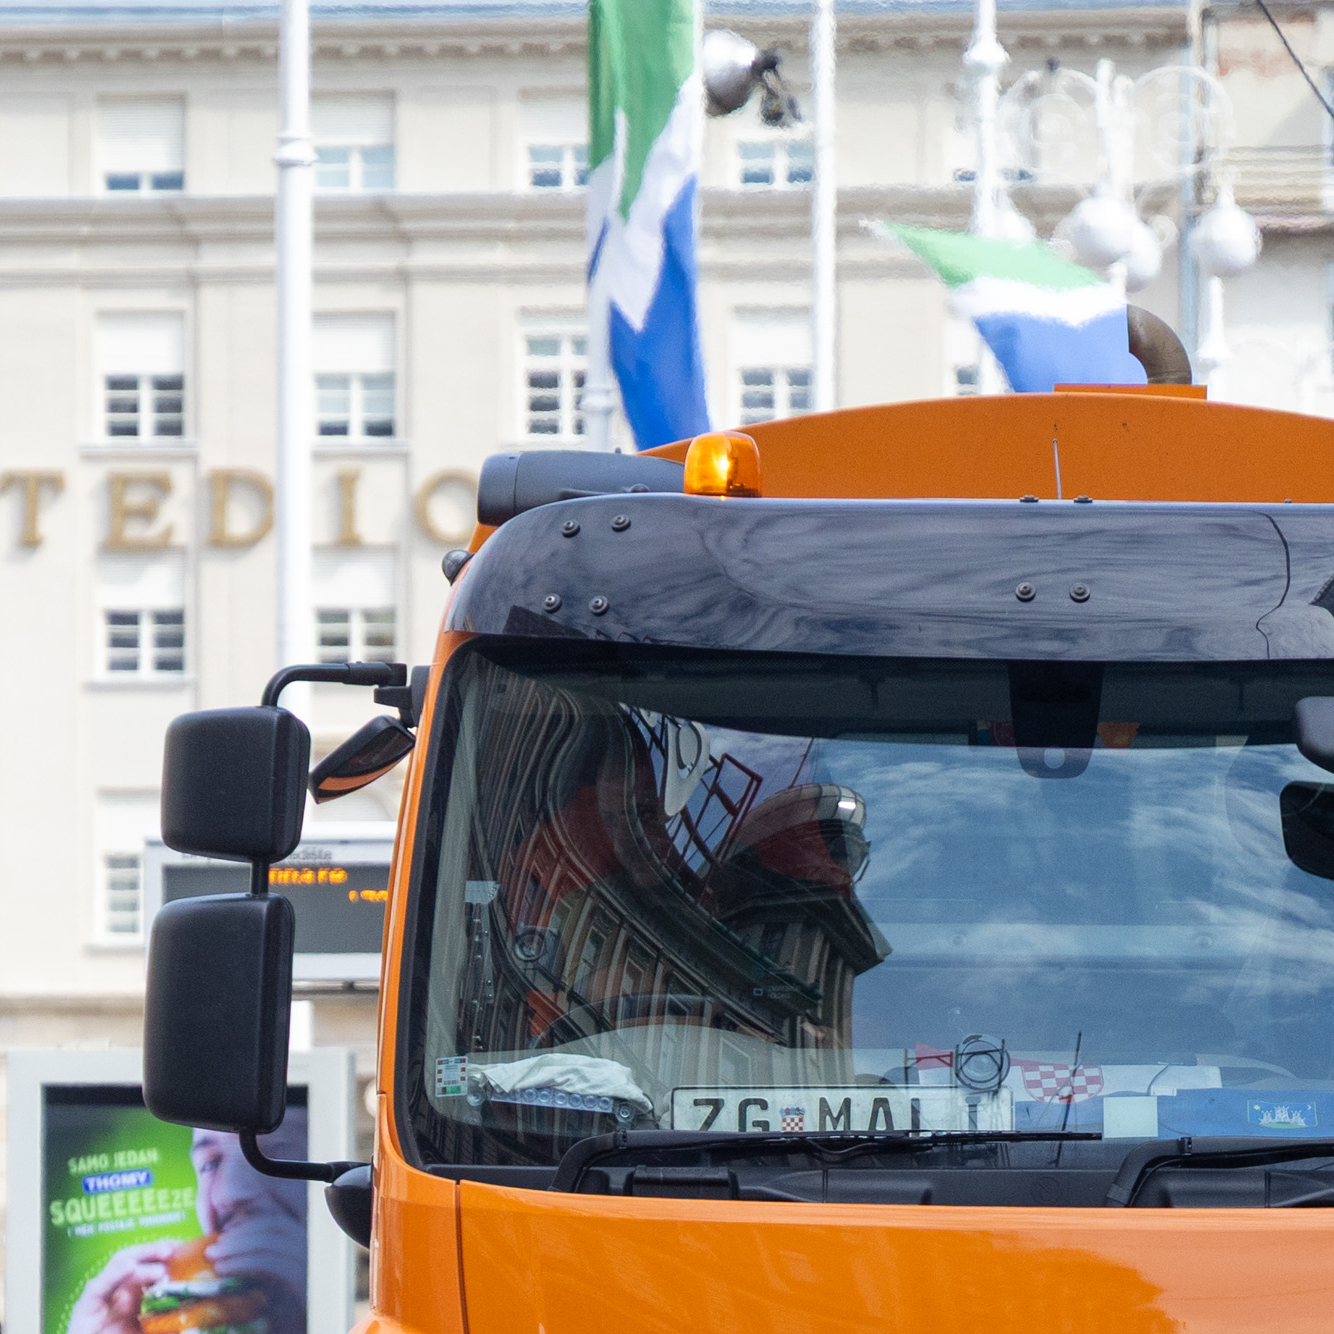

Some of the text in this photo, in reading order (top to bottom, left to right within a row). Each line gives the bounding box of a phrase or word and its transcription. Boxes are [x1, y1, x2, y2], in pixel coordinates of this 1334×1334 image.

[68, 1148, 159, 1176] SAMO JEDAN
[85, 1170, 149, 1191] THOMY
